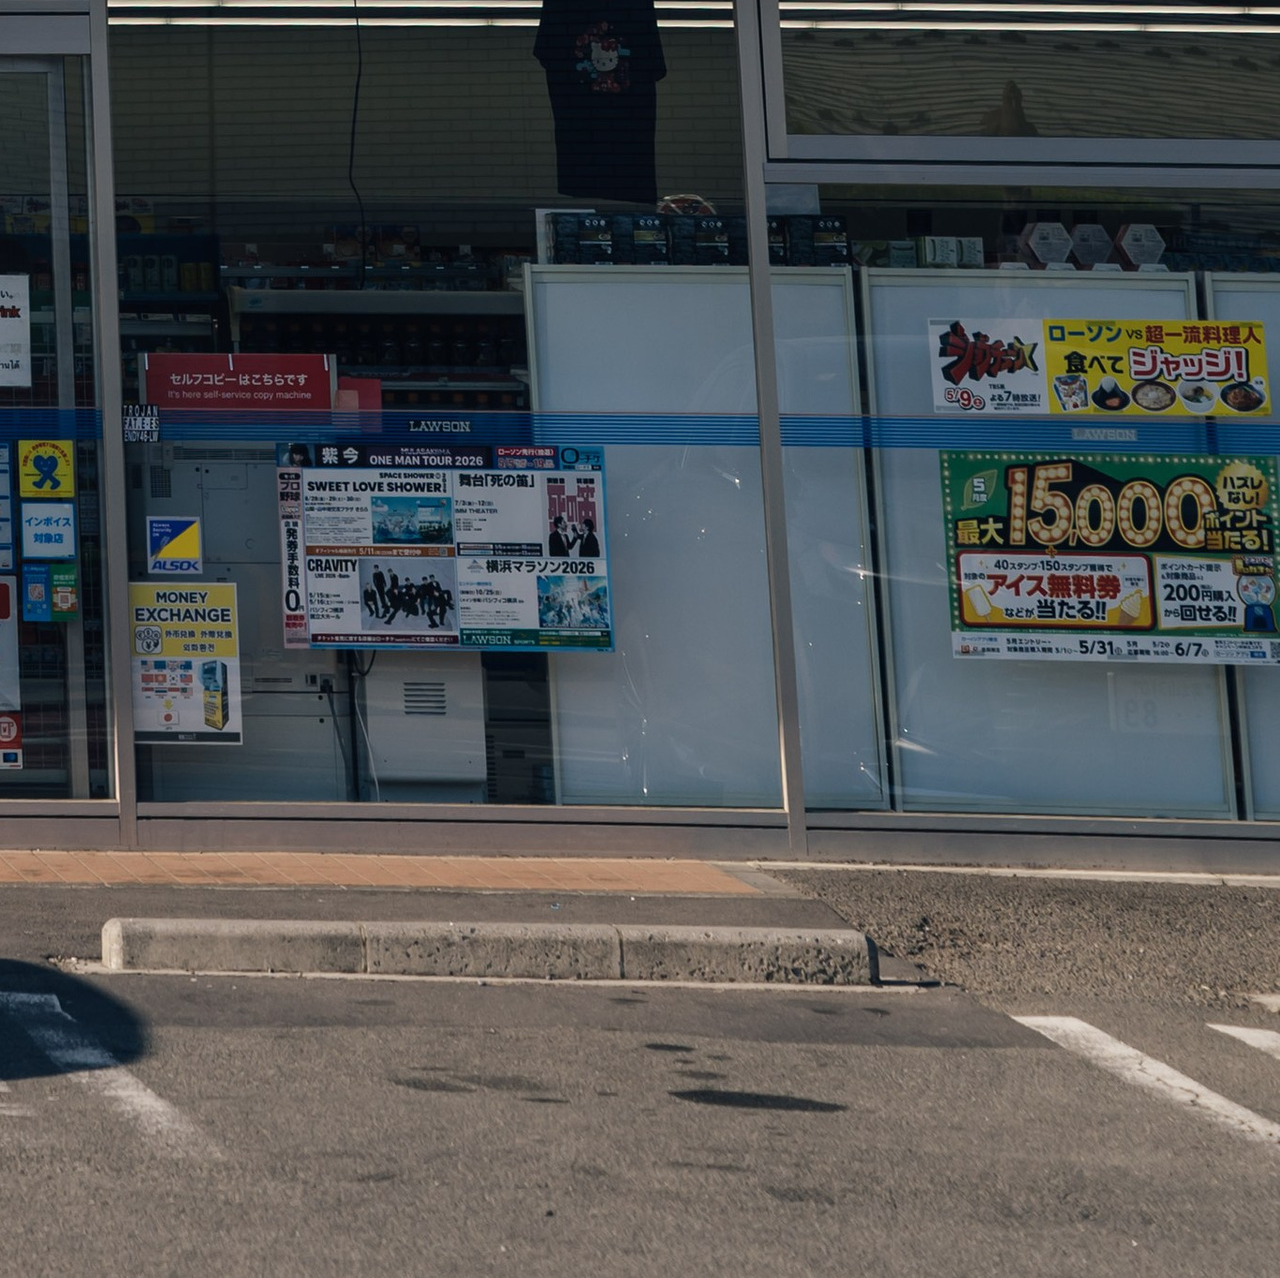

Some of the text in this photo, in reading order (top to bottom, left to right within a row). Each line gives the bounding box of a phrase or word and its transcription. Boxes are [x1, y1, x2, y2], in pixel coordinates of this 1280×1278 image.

[1049, 325, 1122, 342] ローソン
[1145, 325, 1262, 345] 超一流料理人
[1064, 350, 1124, 374] 食べて
[1130, 347, 1247, 381] ジャッジ!
[170, 373, 308, 386] セルフコピーはこちらです
[168, 390, 312, 401] It's here self-service copy machine
[989, 391, 1041, 403] よる7時放送!
[123, 405, 158, 416] TROJAN
[409, 420, 471, 433] LAWSON
[370, 455, 483, 466] ONE MAN TOUR 2026
[280, 482, 300, 491] プロ
[459, 473, 534, 487] 舞台「死の笛」
[1223, 475, 1263, 490] ハズレ
[307, 481, 441, 493] SWEET LOVE SHOWER
[279, 492, 300, 501] 野球
[1228, 490, 1260, 505] なし!
[1007, 461, 1218, 549] 15,000
[25, 517, 71, 527] インボイス
[1204, 509, 1268, 527] ポイント
[33, 533, 64, 544] 対象店
[956, 519, 1005, 545] 最大
[1206, 529, 1270, 551] 当たる!
[151, 561, 199, 571] ALSOK
[307, 559, 357, 572] CRAVITY
[486, 559, 595, 574] 横浜マラソン2026
[1161, 563, 1221, 572] ポイントカード提示
[986, 574, 1121, 599] アイス無料券
[1163, 584, 1236, 602] 200円購入
[156, 592, 208, 603] MONEY
[135, 609, 231, 622] EXCHANGE
[463, 635, 511, 644] LAWSON
